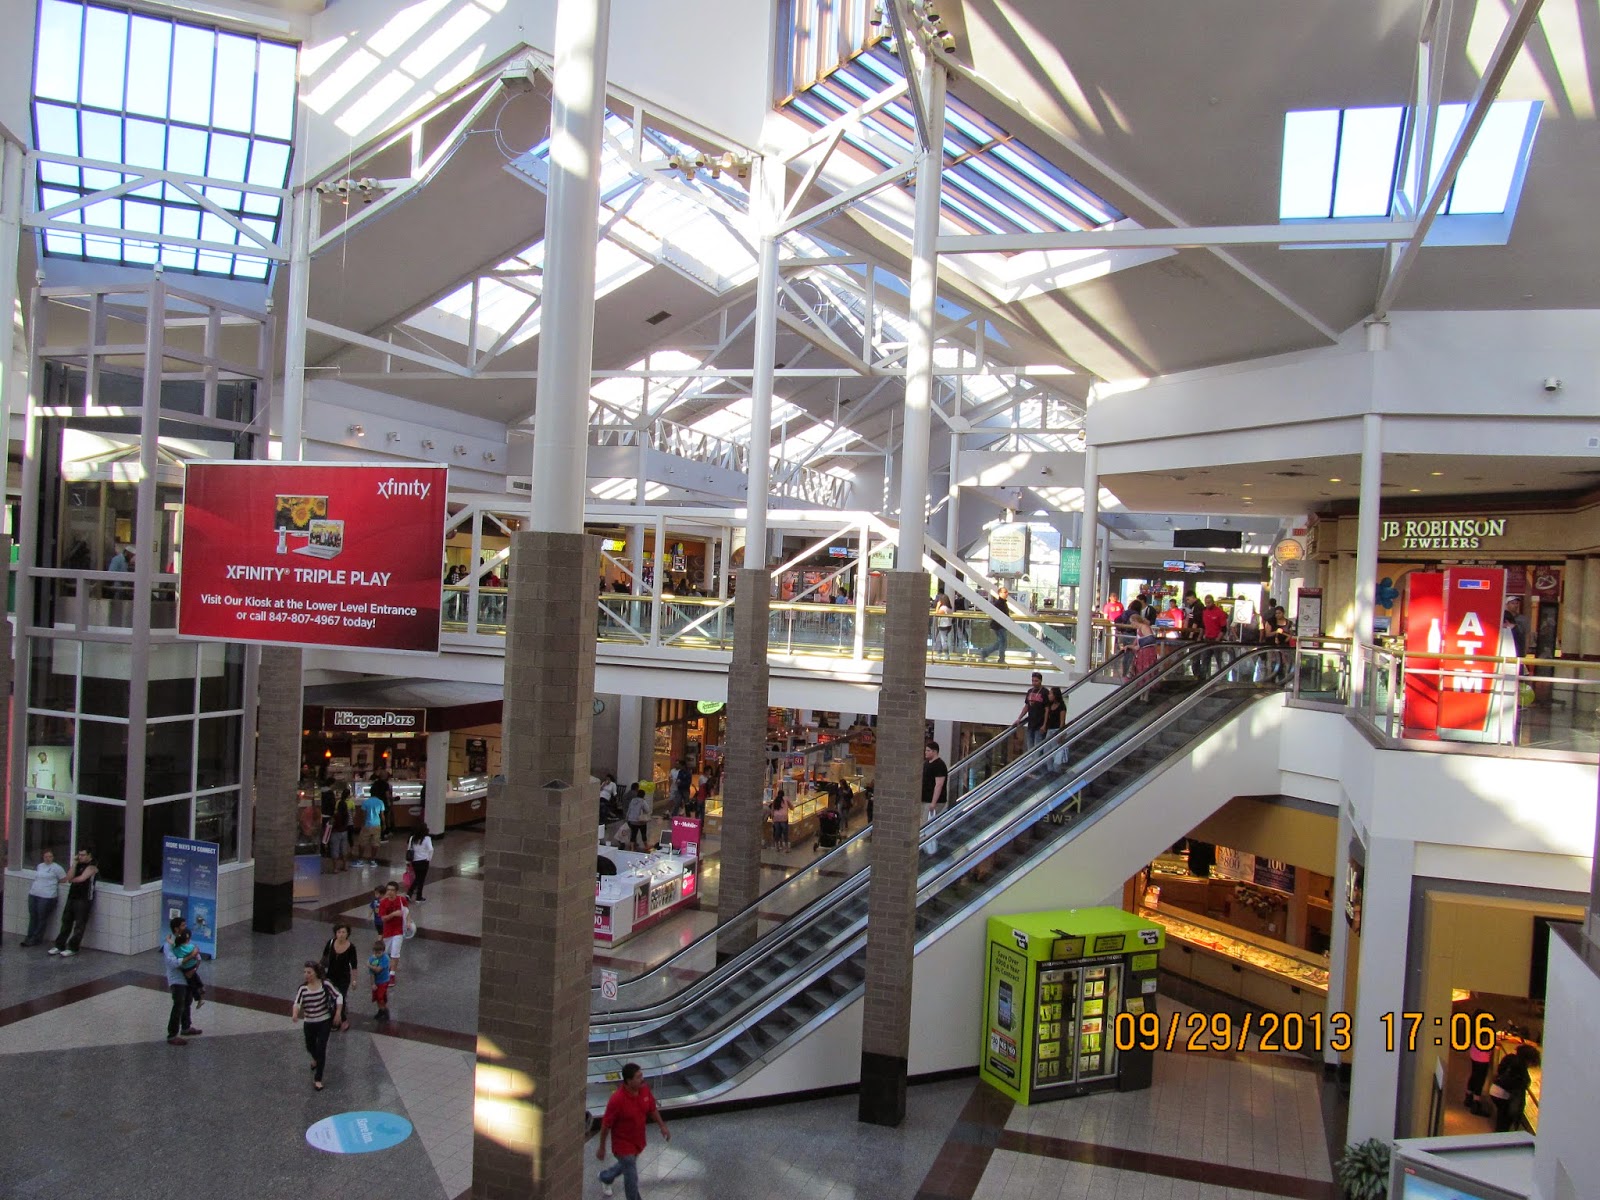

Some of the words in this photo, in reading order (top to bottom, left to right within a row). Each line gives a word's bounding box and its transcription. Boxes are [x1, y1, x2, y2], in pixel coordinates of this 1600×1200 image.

[377, 478, 431, 500] xfinity
[1381, 522, 1400, 541] JB
[1405, 520, 1506, 536] ROBINSON
[1402, 538, 1479, 548] JEWELERS
[294, 568, 346, 584] TRIPLE
[350, 571, 391, 586] PLAY
[201, 594, 221, 604] Visit
[224, 595, 242, 606] Our
[245, 596, 272, 608] Kiosk
[274, 599, 284, 608] at
[287, 598, 303, 609] the
[306, 600, 338, 612] Lower
[340, 602, 367, 613] Level
[370, 604, 417, 616] Entrance
[236, 612, 247, 620] or
[250, 611, 266, 620] call
[269, 612, 340, 625] 847-807-4967
[343, 616, 376, 630] today!
